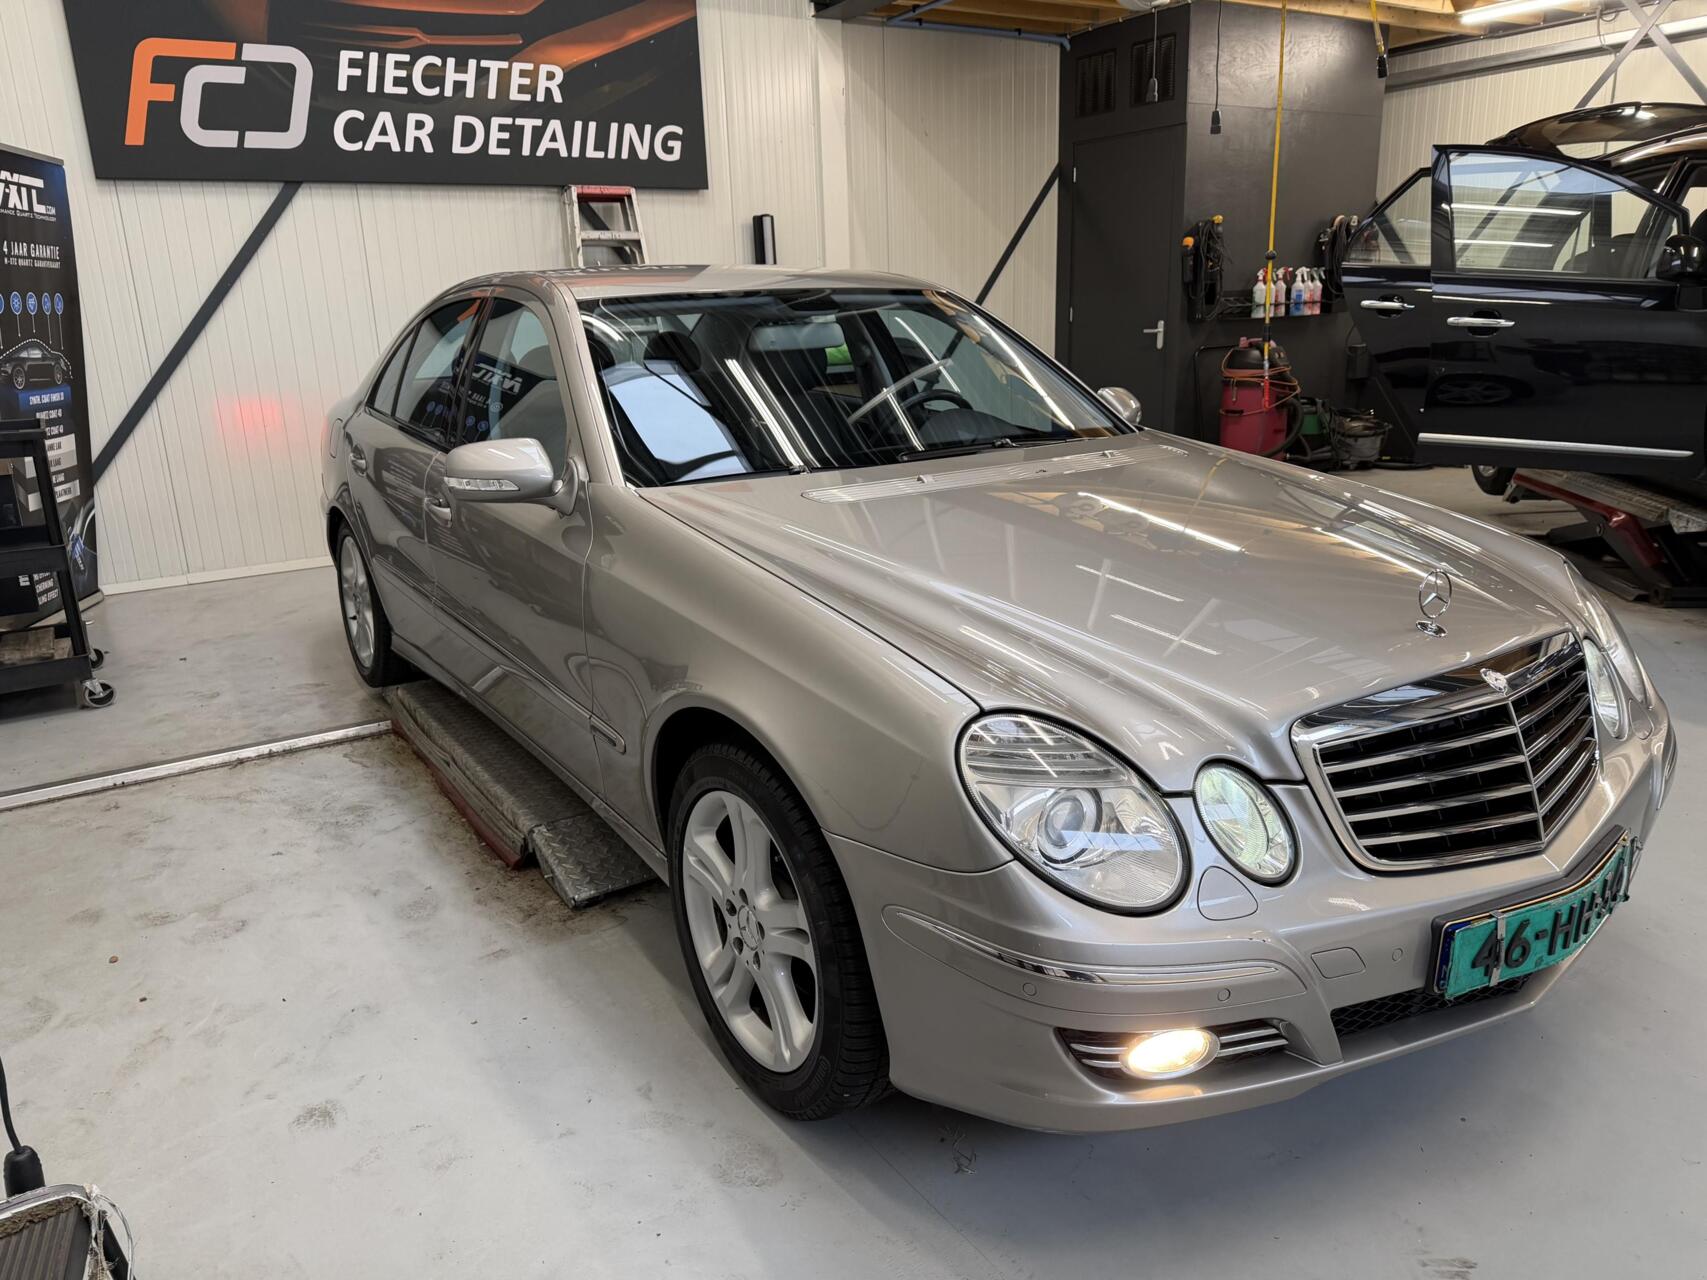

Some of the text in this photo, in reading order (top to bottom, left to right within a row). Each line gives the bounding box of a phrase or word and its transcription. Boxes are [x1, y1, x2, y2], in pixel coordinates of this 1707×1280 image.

[338, 50, 563, 103] FIECHTER
[334, 109, 683, 162] CAR DETAILING
[3, 240, 60, 260] 4 JAAR GARANTIE
